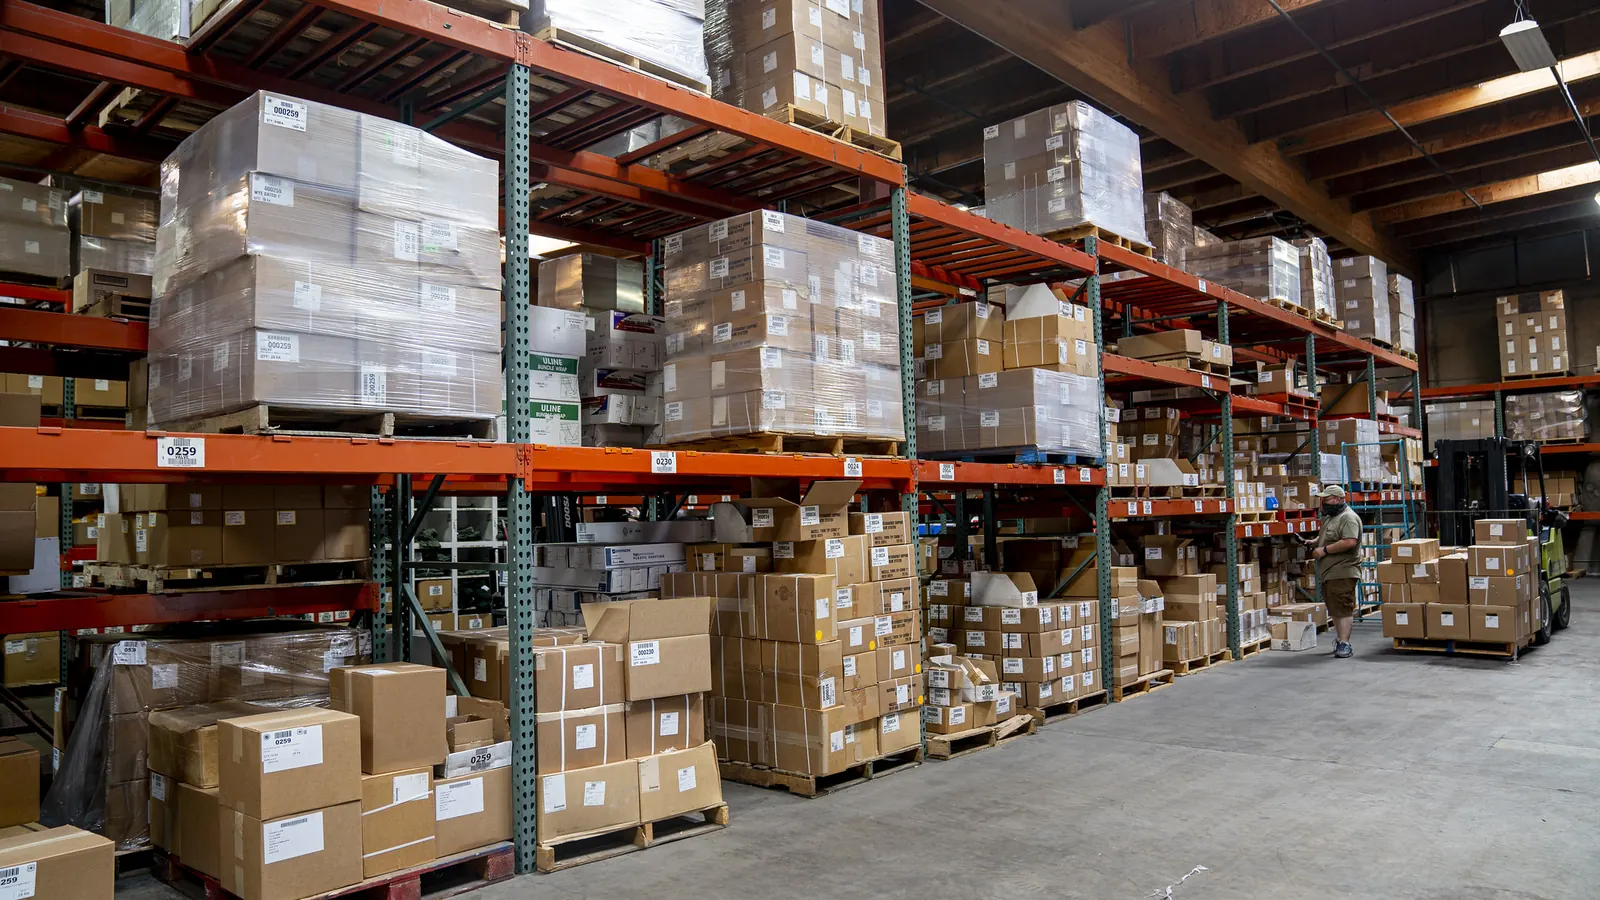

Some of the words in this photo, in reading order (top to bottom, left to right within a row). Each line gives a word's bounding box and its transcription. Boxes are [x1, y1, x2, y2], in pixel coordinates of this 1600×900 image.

[273, 106, 300, 118] 000259
[268, 341, 291, 349] 000259
[542, 357, 563, 366] ULINE
[541, 404, 562, 413] ULINE
[167, 446, 197, 456] 0259
[656, 457, 673, 466] 0230
[563, 495, 572, 528] DOOSA
[637, 648, 655, 656] 000230
[275, 737, 292, 745] 0259
[470, 753, 492, 764] 0259
[0, 876, 18, 886] 259
